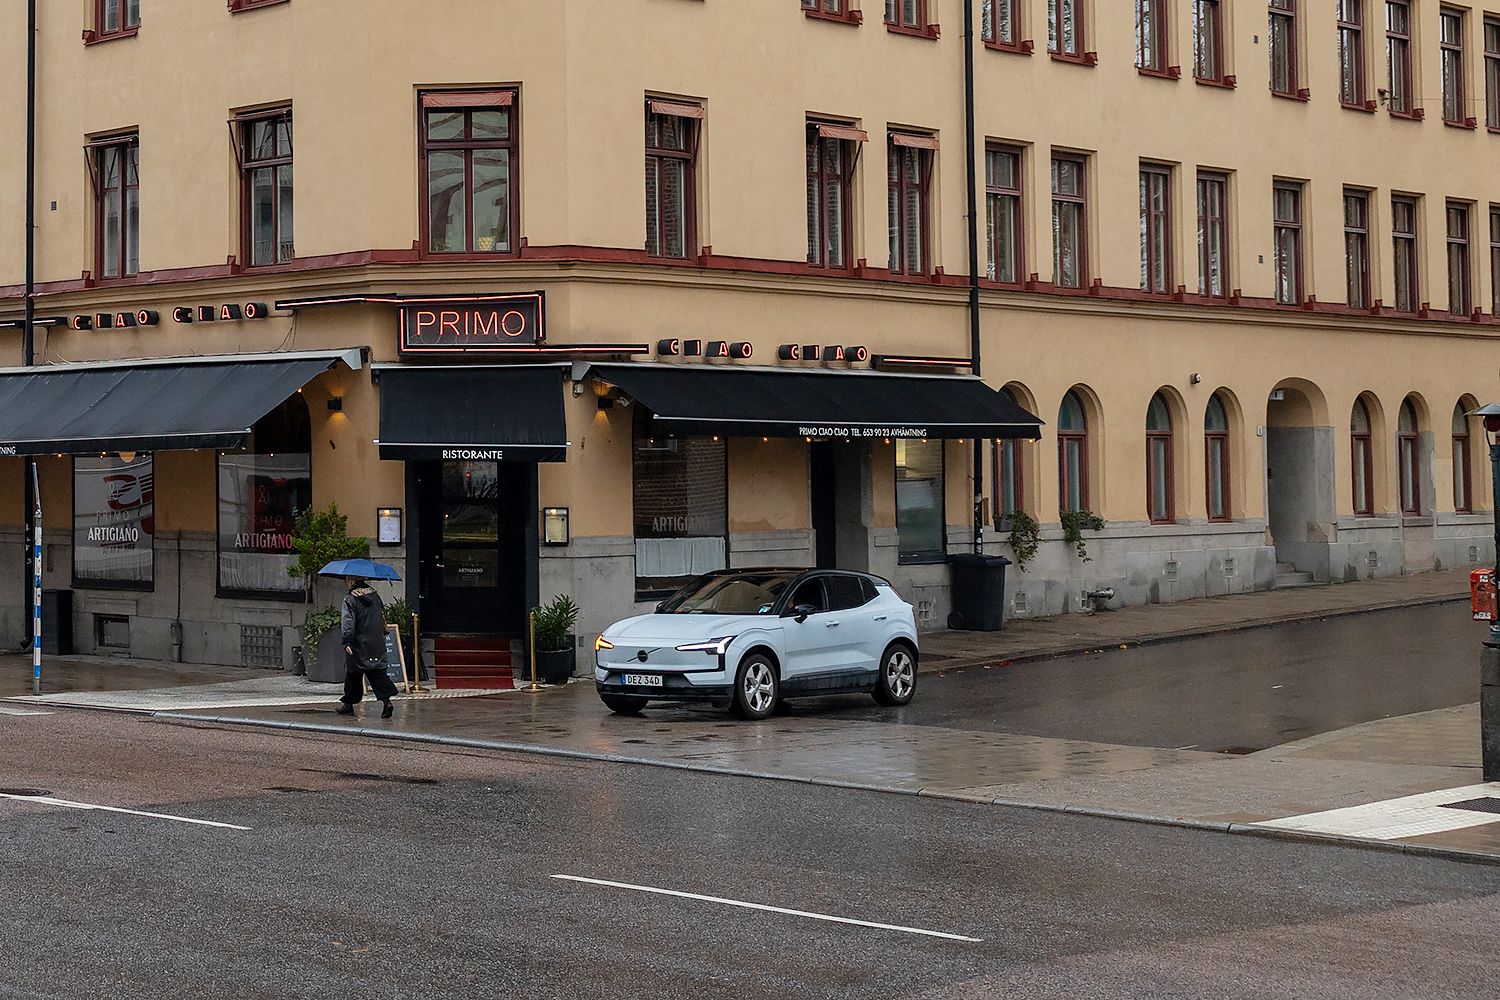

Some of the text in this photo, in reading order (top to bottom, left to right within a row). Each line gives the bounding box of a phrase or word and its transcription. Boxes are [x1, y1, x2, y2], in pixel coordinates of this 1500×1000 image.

[73, 303, 257, 330] CIAO CIAO
[416, 310, 526, 337] PRIMO
[669, 339, 868, 361] CIAO CIAO
[799, 427, 818, 436] PRIMO
[818, 427, 833, 436] CIAO
[833, 428, 849, 436] CIAO
[862, 428, 874, 436] 653
[874, 428, 882, 436] 90
[882, 428, 890, 436] 23
[890, 427, 927, 437] AVHÄMTNING
[442, 449, 503, 460] RISTORANTE
[87, 527, 139, 542] ARTIGIANO
[234, 532, 293, 549] ARTIGIANO
[627, 675, 642, 685] DEZ
